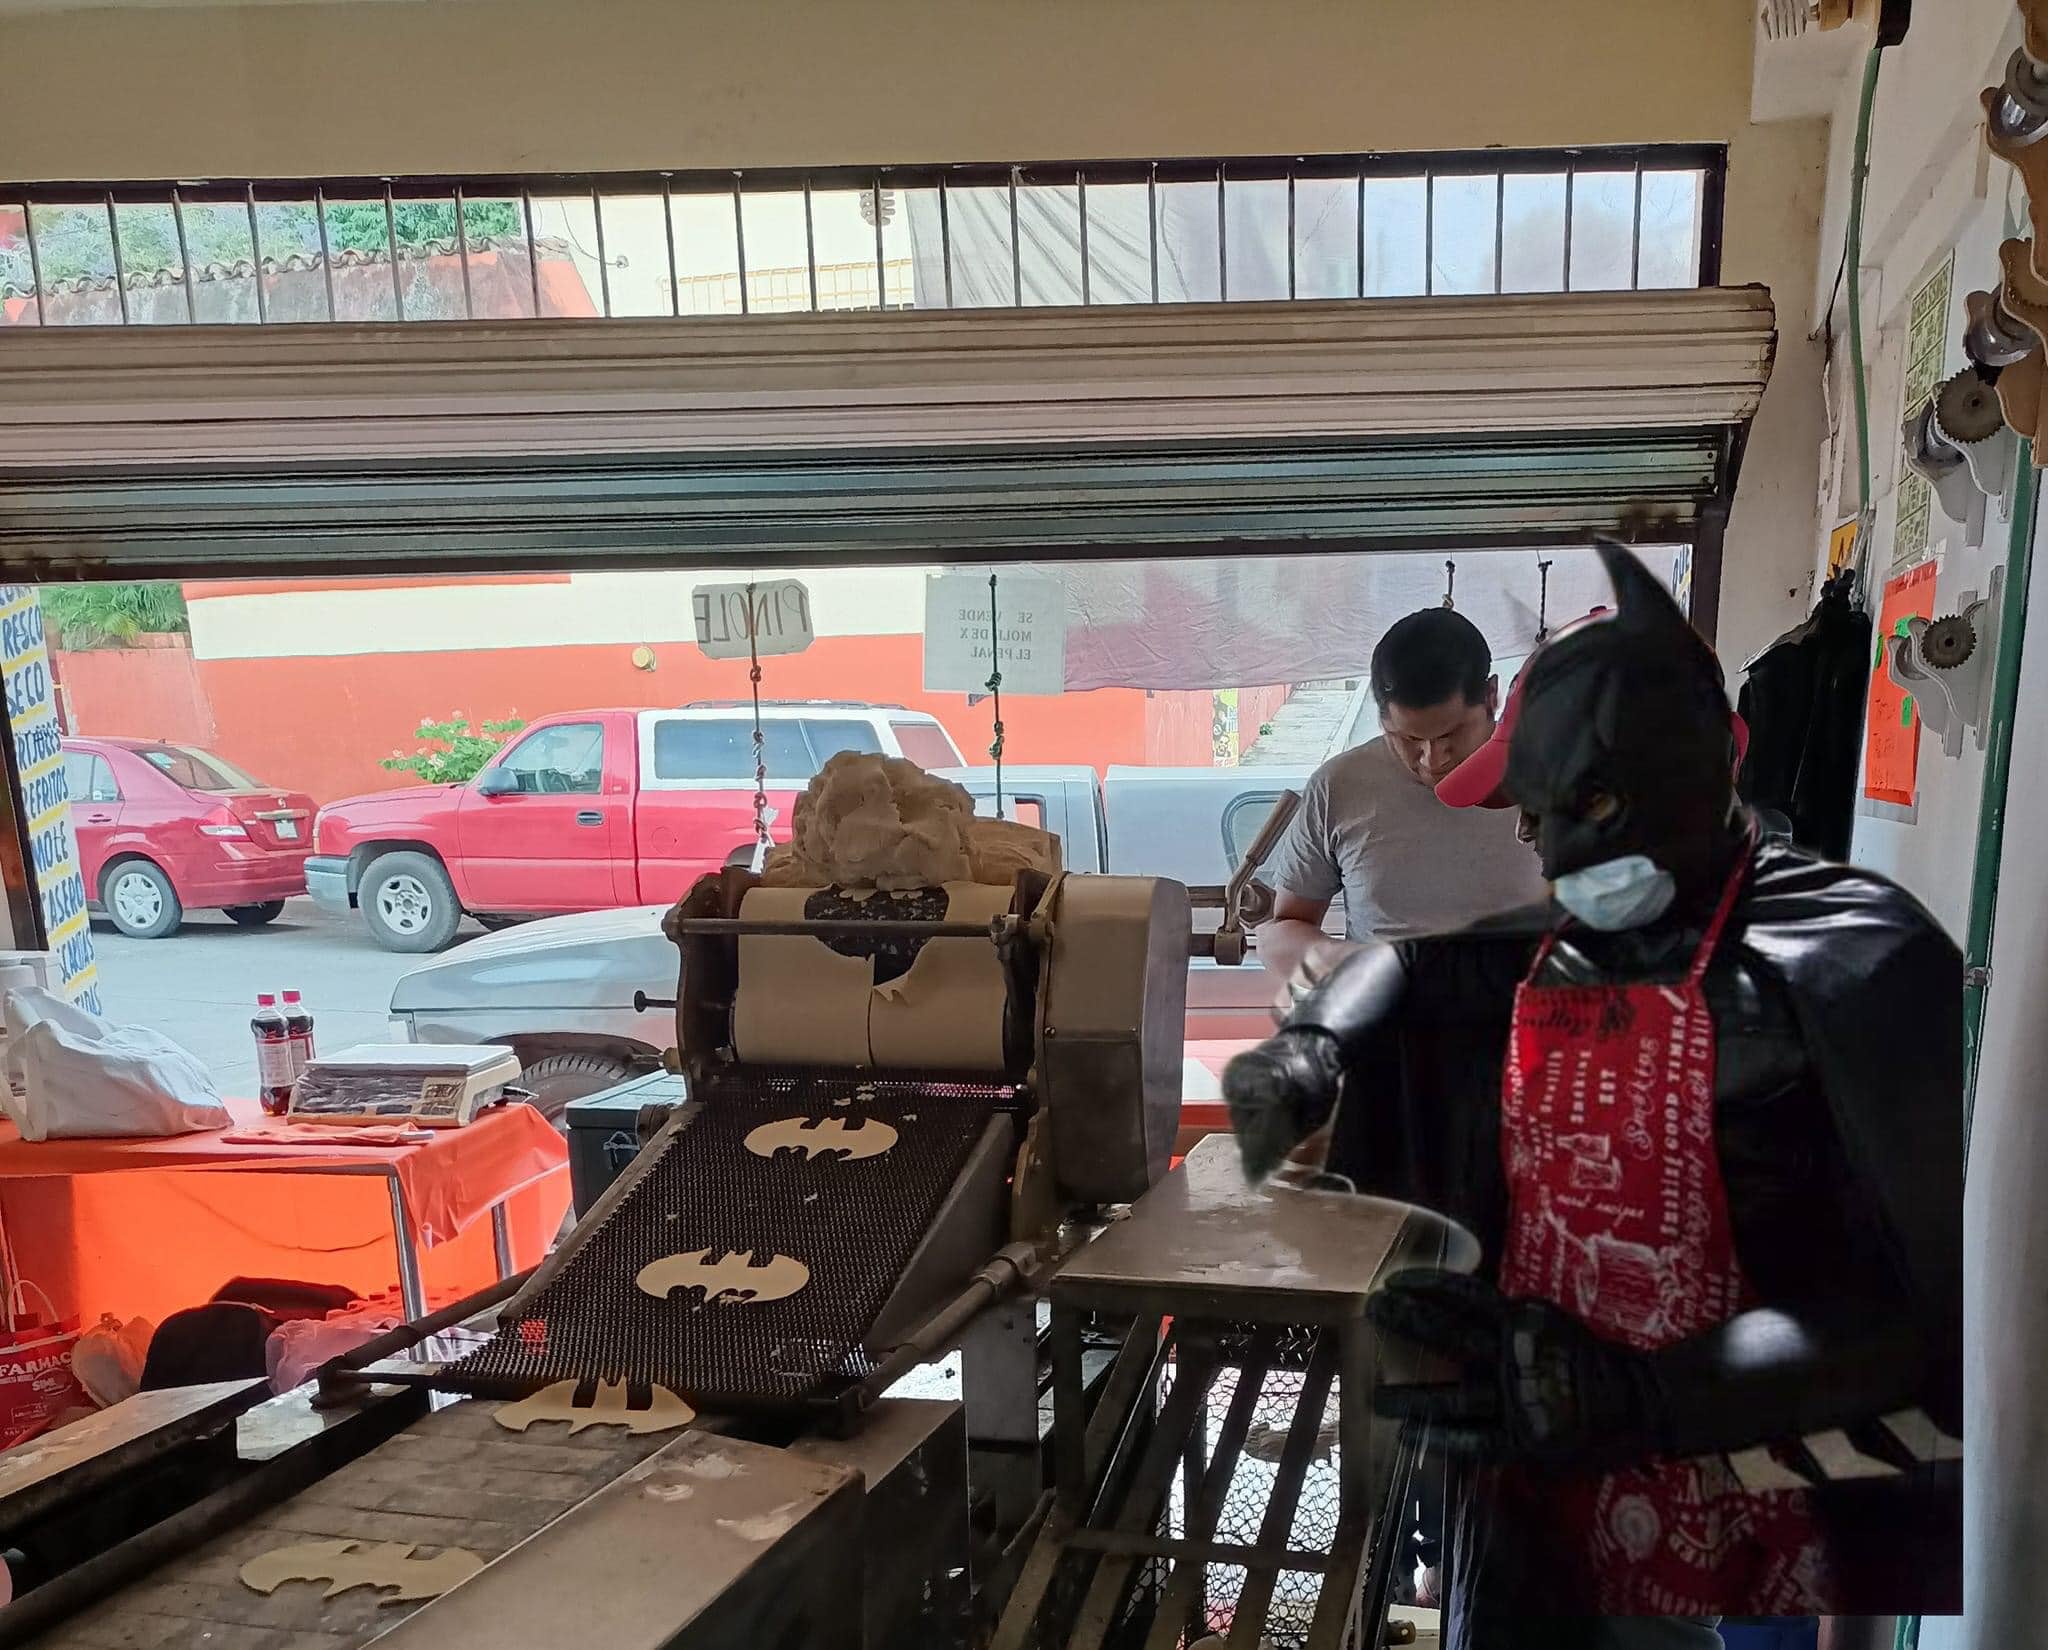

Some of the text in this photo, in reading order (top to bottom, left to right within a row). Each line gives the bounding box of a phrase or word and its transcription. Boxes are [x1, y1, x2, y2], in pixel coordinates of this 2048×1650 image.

[13, 717, 62, 771] RIJOLES
[31, 820, 69, 873] MOLE
[1667, 1015, 1686, 1082] TIMES
[1664, 1092, 1680, 1150] GOOD
